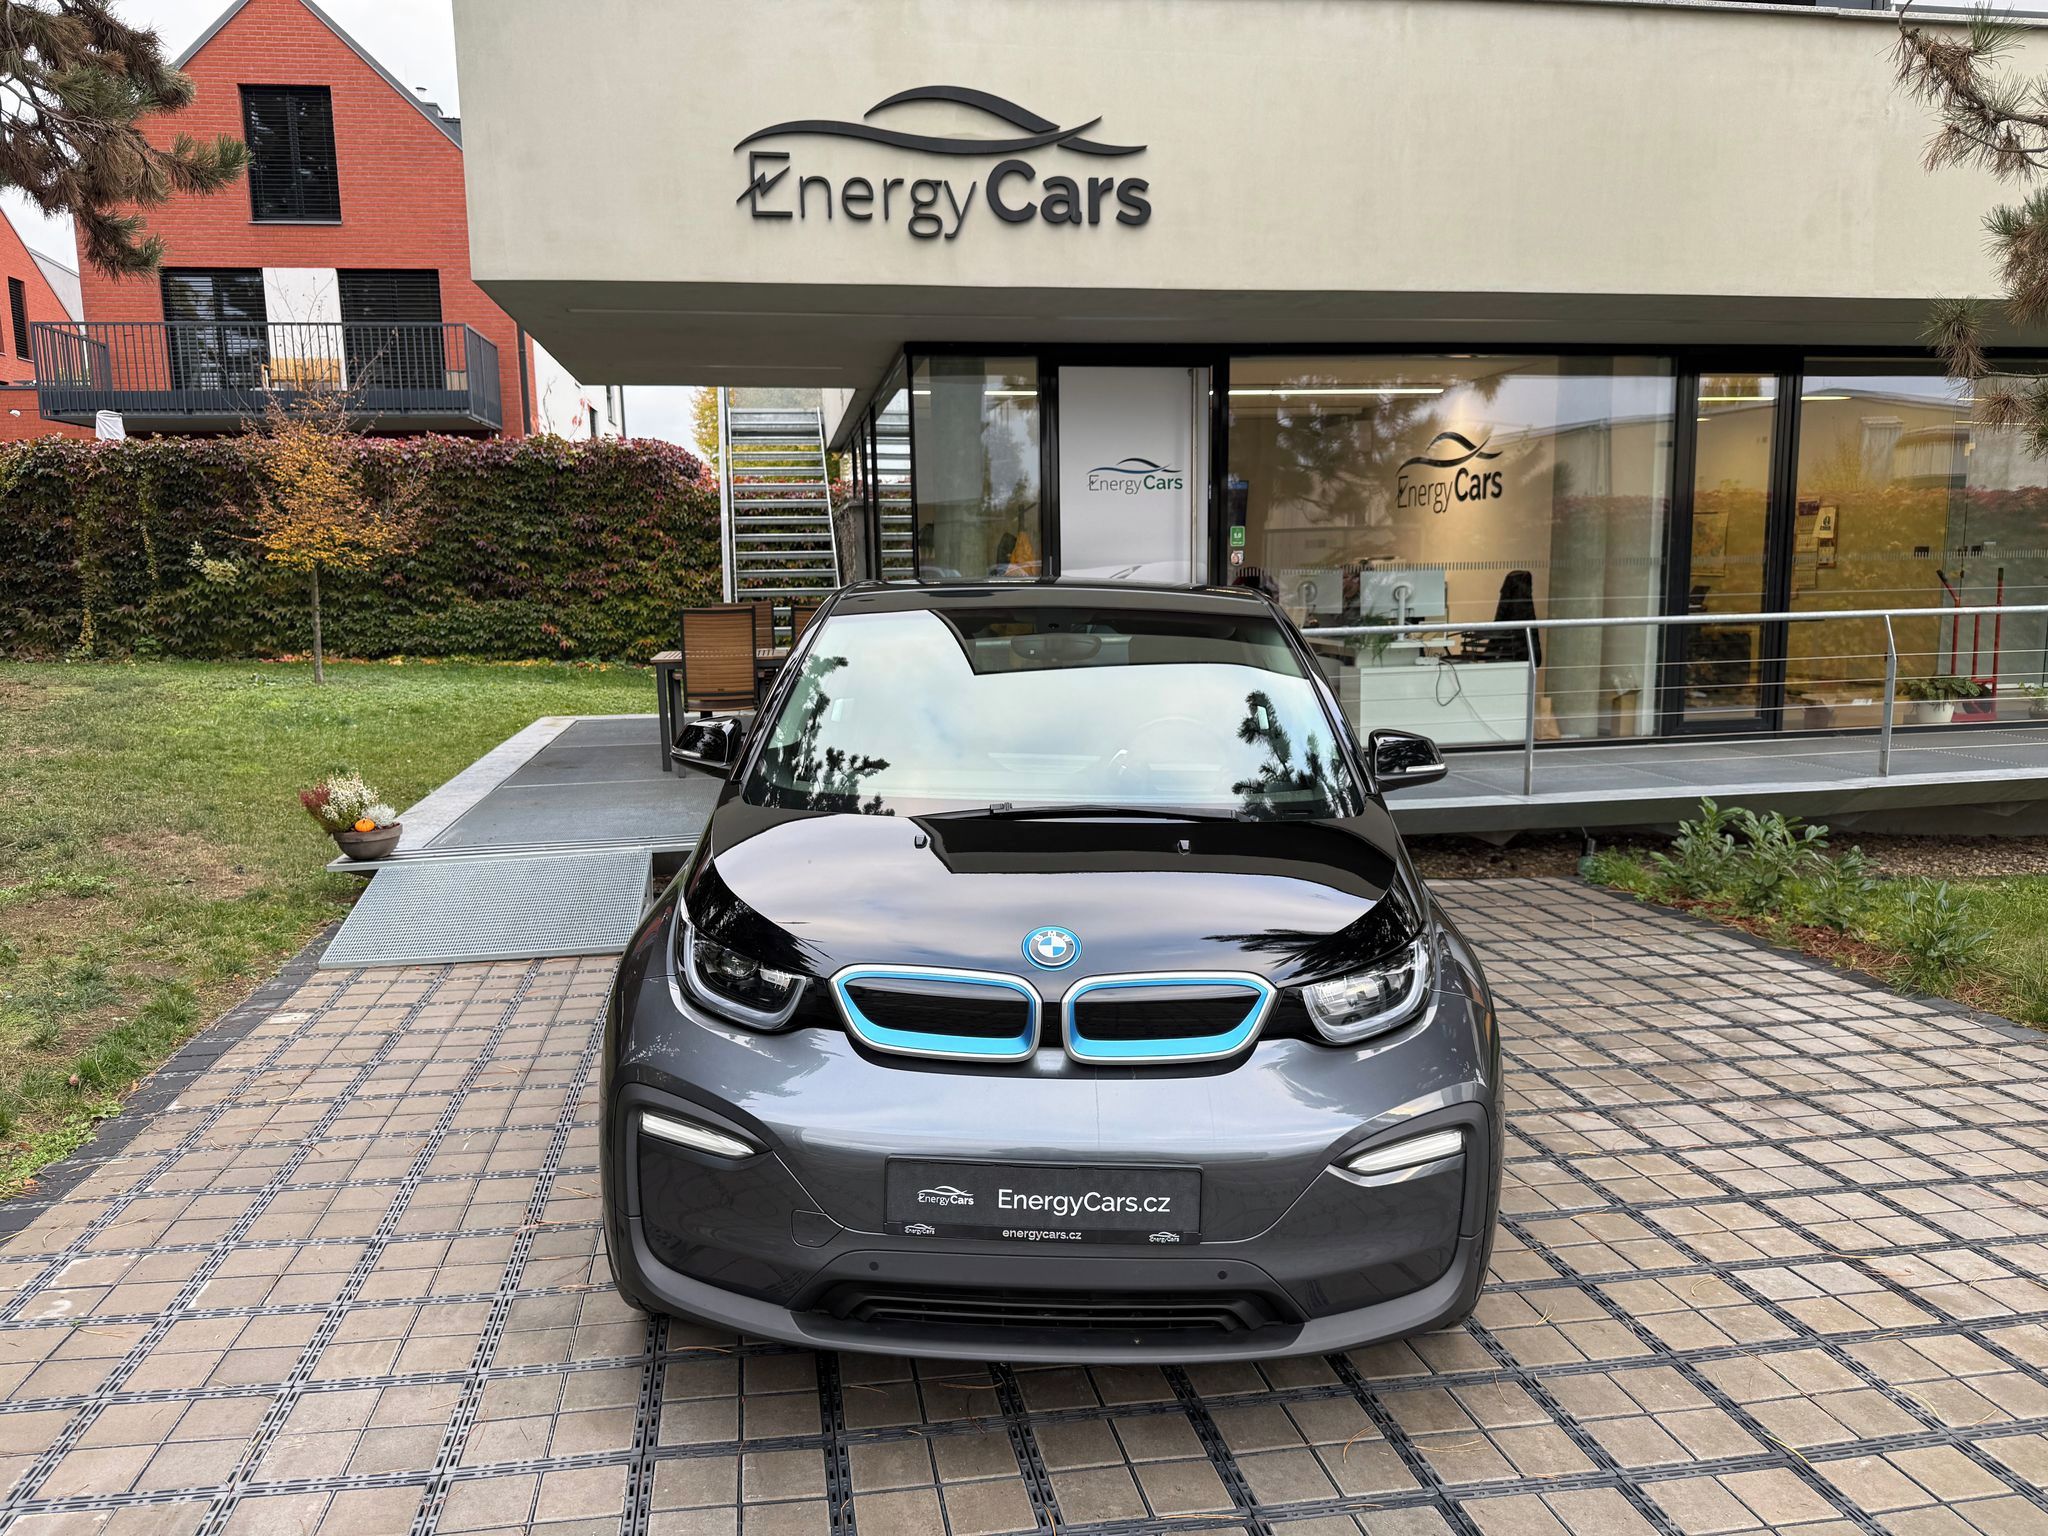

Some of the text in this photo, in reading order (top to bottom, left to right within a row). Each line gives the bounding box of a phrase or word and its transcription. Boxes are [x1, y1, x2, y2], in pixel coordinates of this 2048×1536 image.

[737, 151, 1152, 239] EnergyCars
[1089, 474, 1183, 495] EnergyCars
[1397, 467, 1503, 514] EnergyCars
[918, 1193, 975, 1206] EnergyCars
[998, 1188, 1171, 1217] EnergyCars.cz
[1002, 1228, 1082, 1241] energycars.cz
